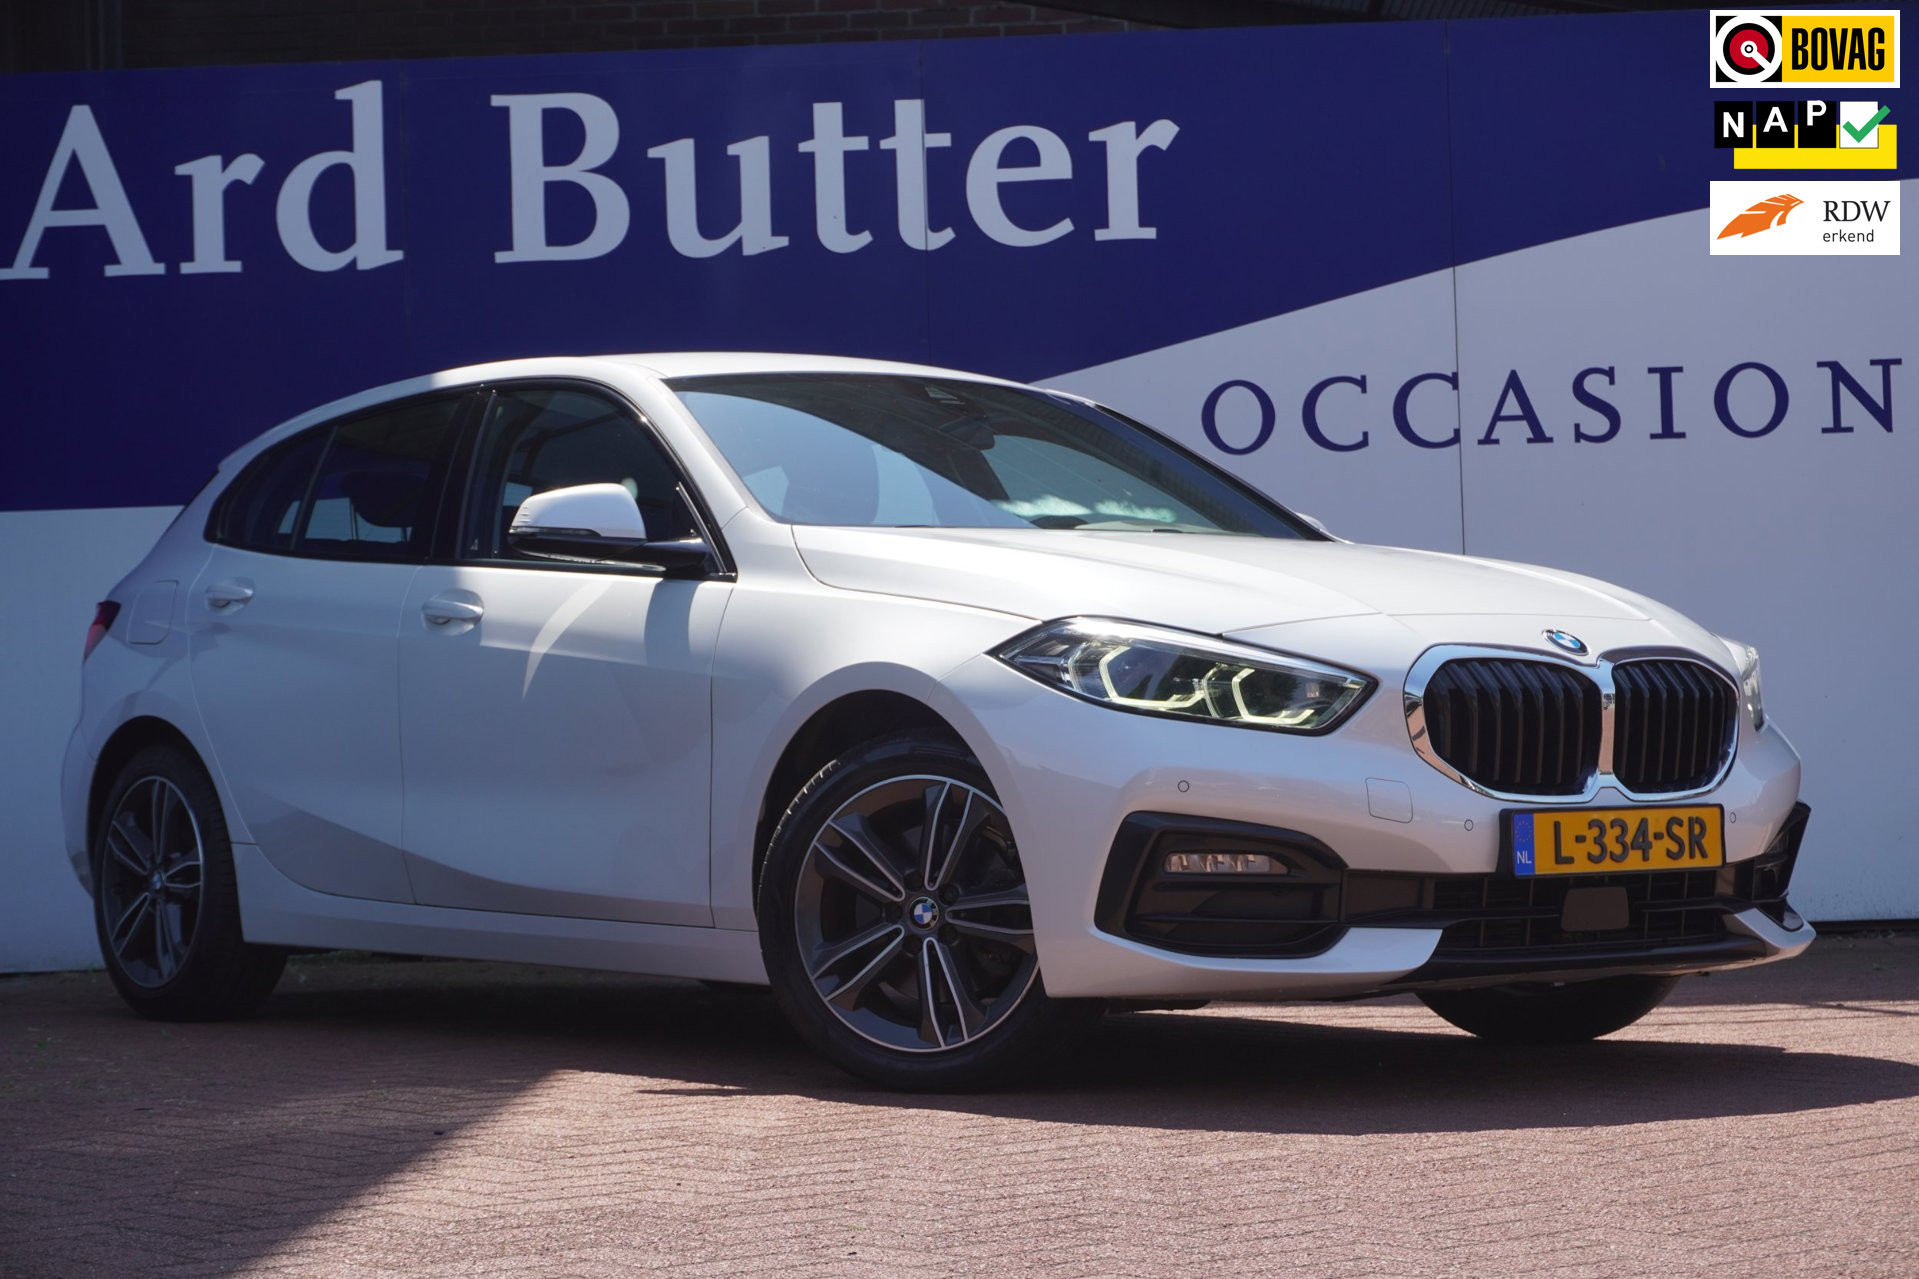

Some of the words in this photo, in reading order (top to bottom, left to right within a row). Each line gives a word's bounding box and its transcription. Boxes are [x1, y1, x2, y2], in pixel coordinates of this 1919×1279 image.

[0, 80, 404, 280] Ard
[490, 92, 1180, 264] Butter
[1201, 358, 1903, 455] OCCASION
[1516, 851, 1532, 864] NL
[1553, 816, 1708, 865] L-334-SR
